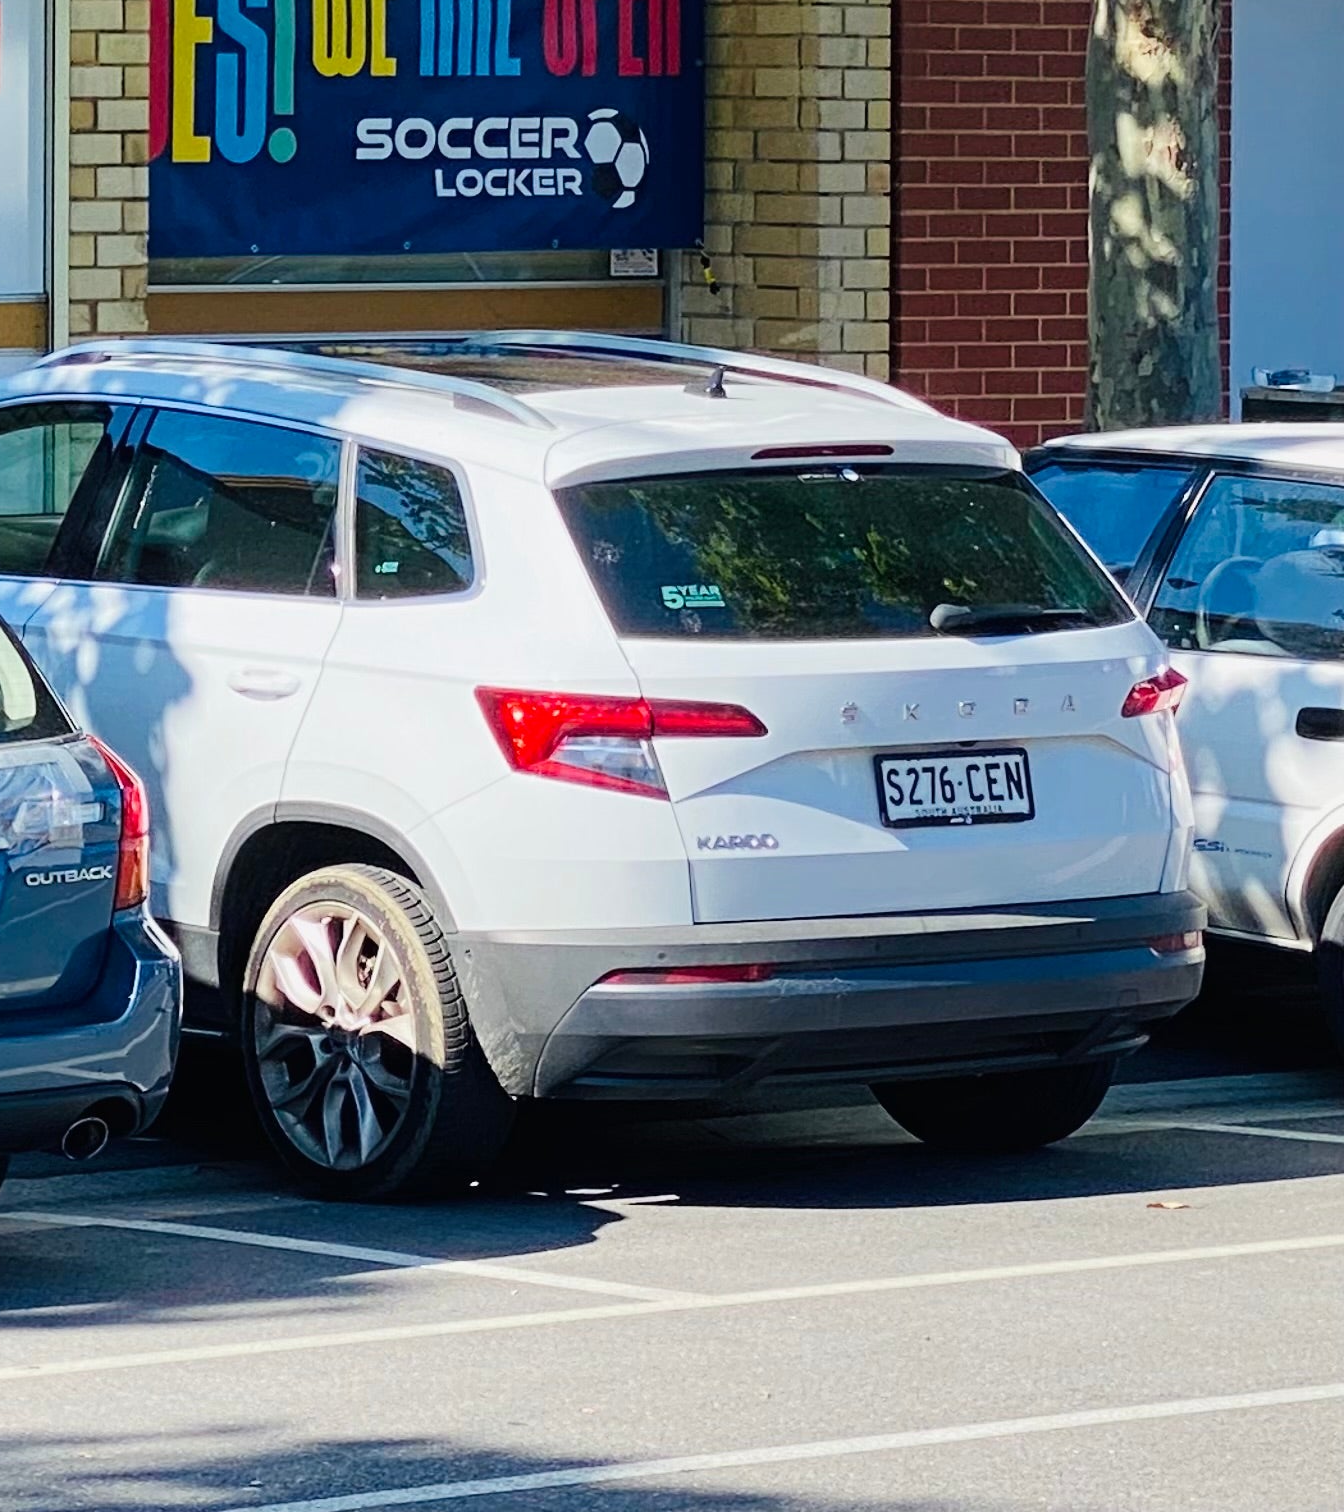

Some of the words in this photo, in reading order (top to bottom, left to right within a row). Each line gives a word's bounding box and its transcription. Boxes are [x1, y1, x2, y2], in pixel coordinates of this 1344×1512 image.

[355, 117, 581, 160] SOCCER
[435, 168, 583, 197] LOCKER
[661, 586, 684, 609] 5
[677, 584, 721, 600] YEAR
[26, 866, 113, 886] OUTBACK
